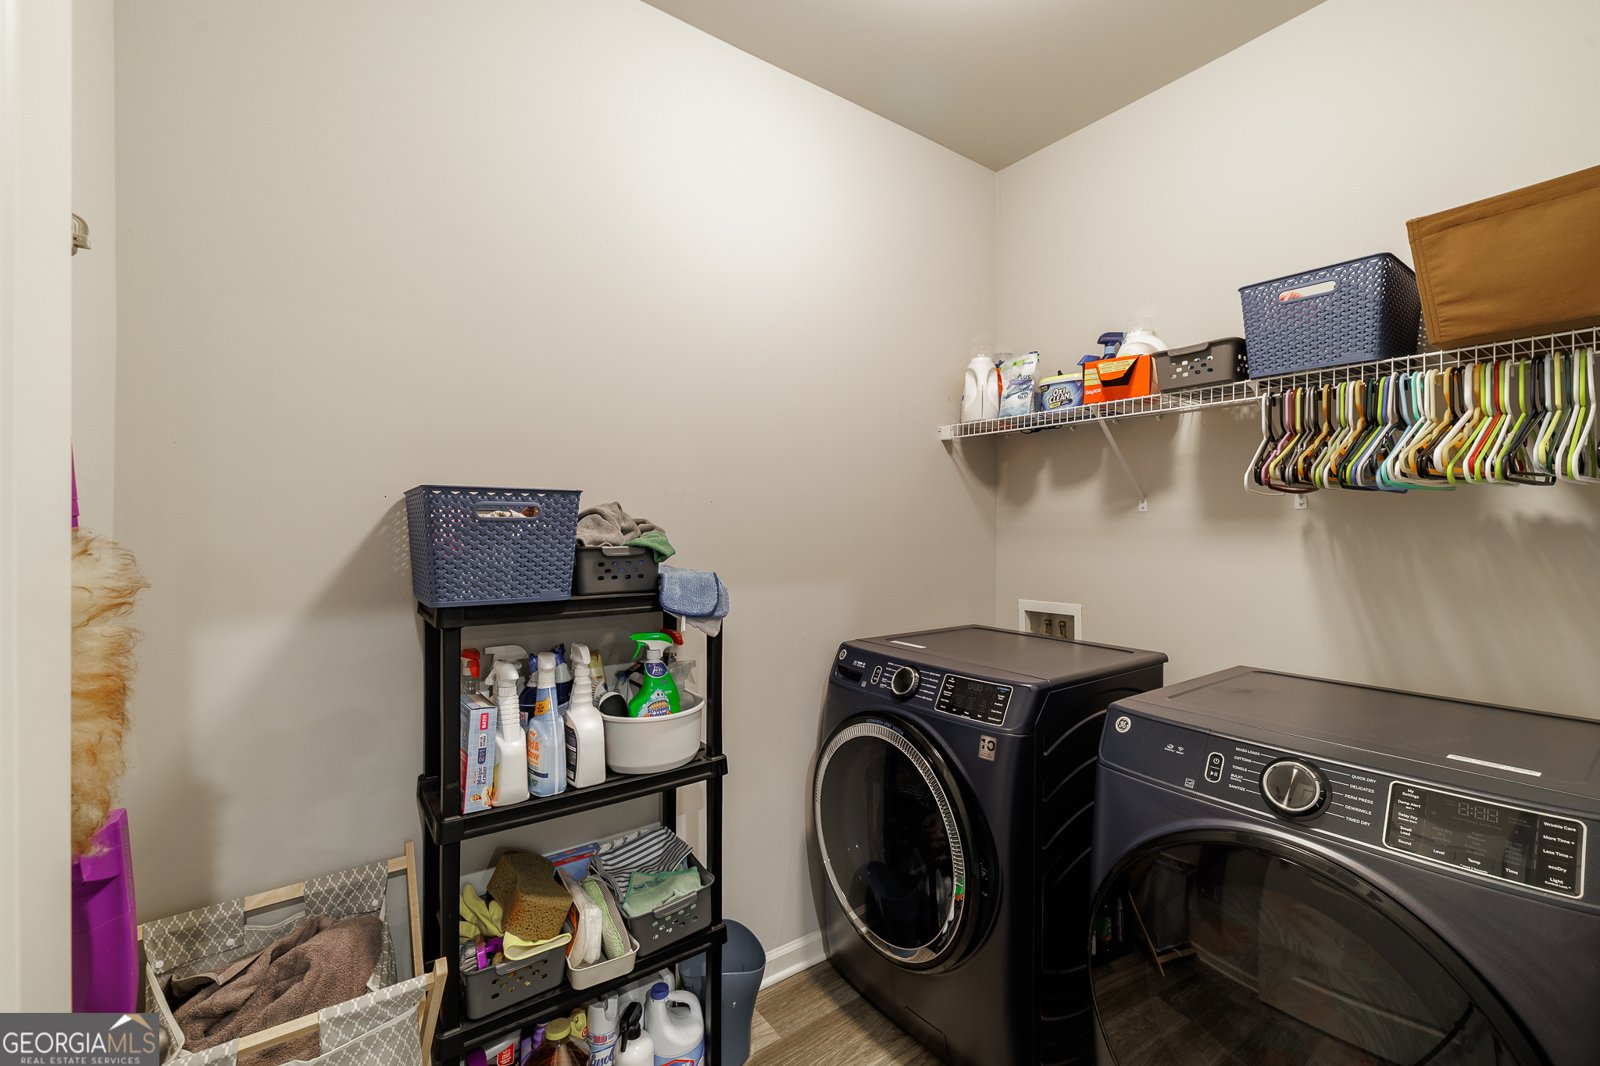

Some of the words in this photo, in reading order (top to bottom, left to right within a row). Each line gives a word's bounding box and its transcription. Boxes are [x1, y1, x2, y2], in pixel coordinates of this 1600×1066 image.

[1053, 387, 1066, 396] OXI
[1048, 392, 1070, 403] CLEAN
[981, 738, 995, 751] 10
[1350, 784, 1374, 793] DELICATES
[1345, 805, 1372, 815] DEWRINKLE
